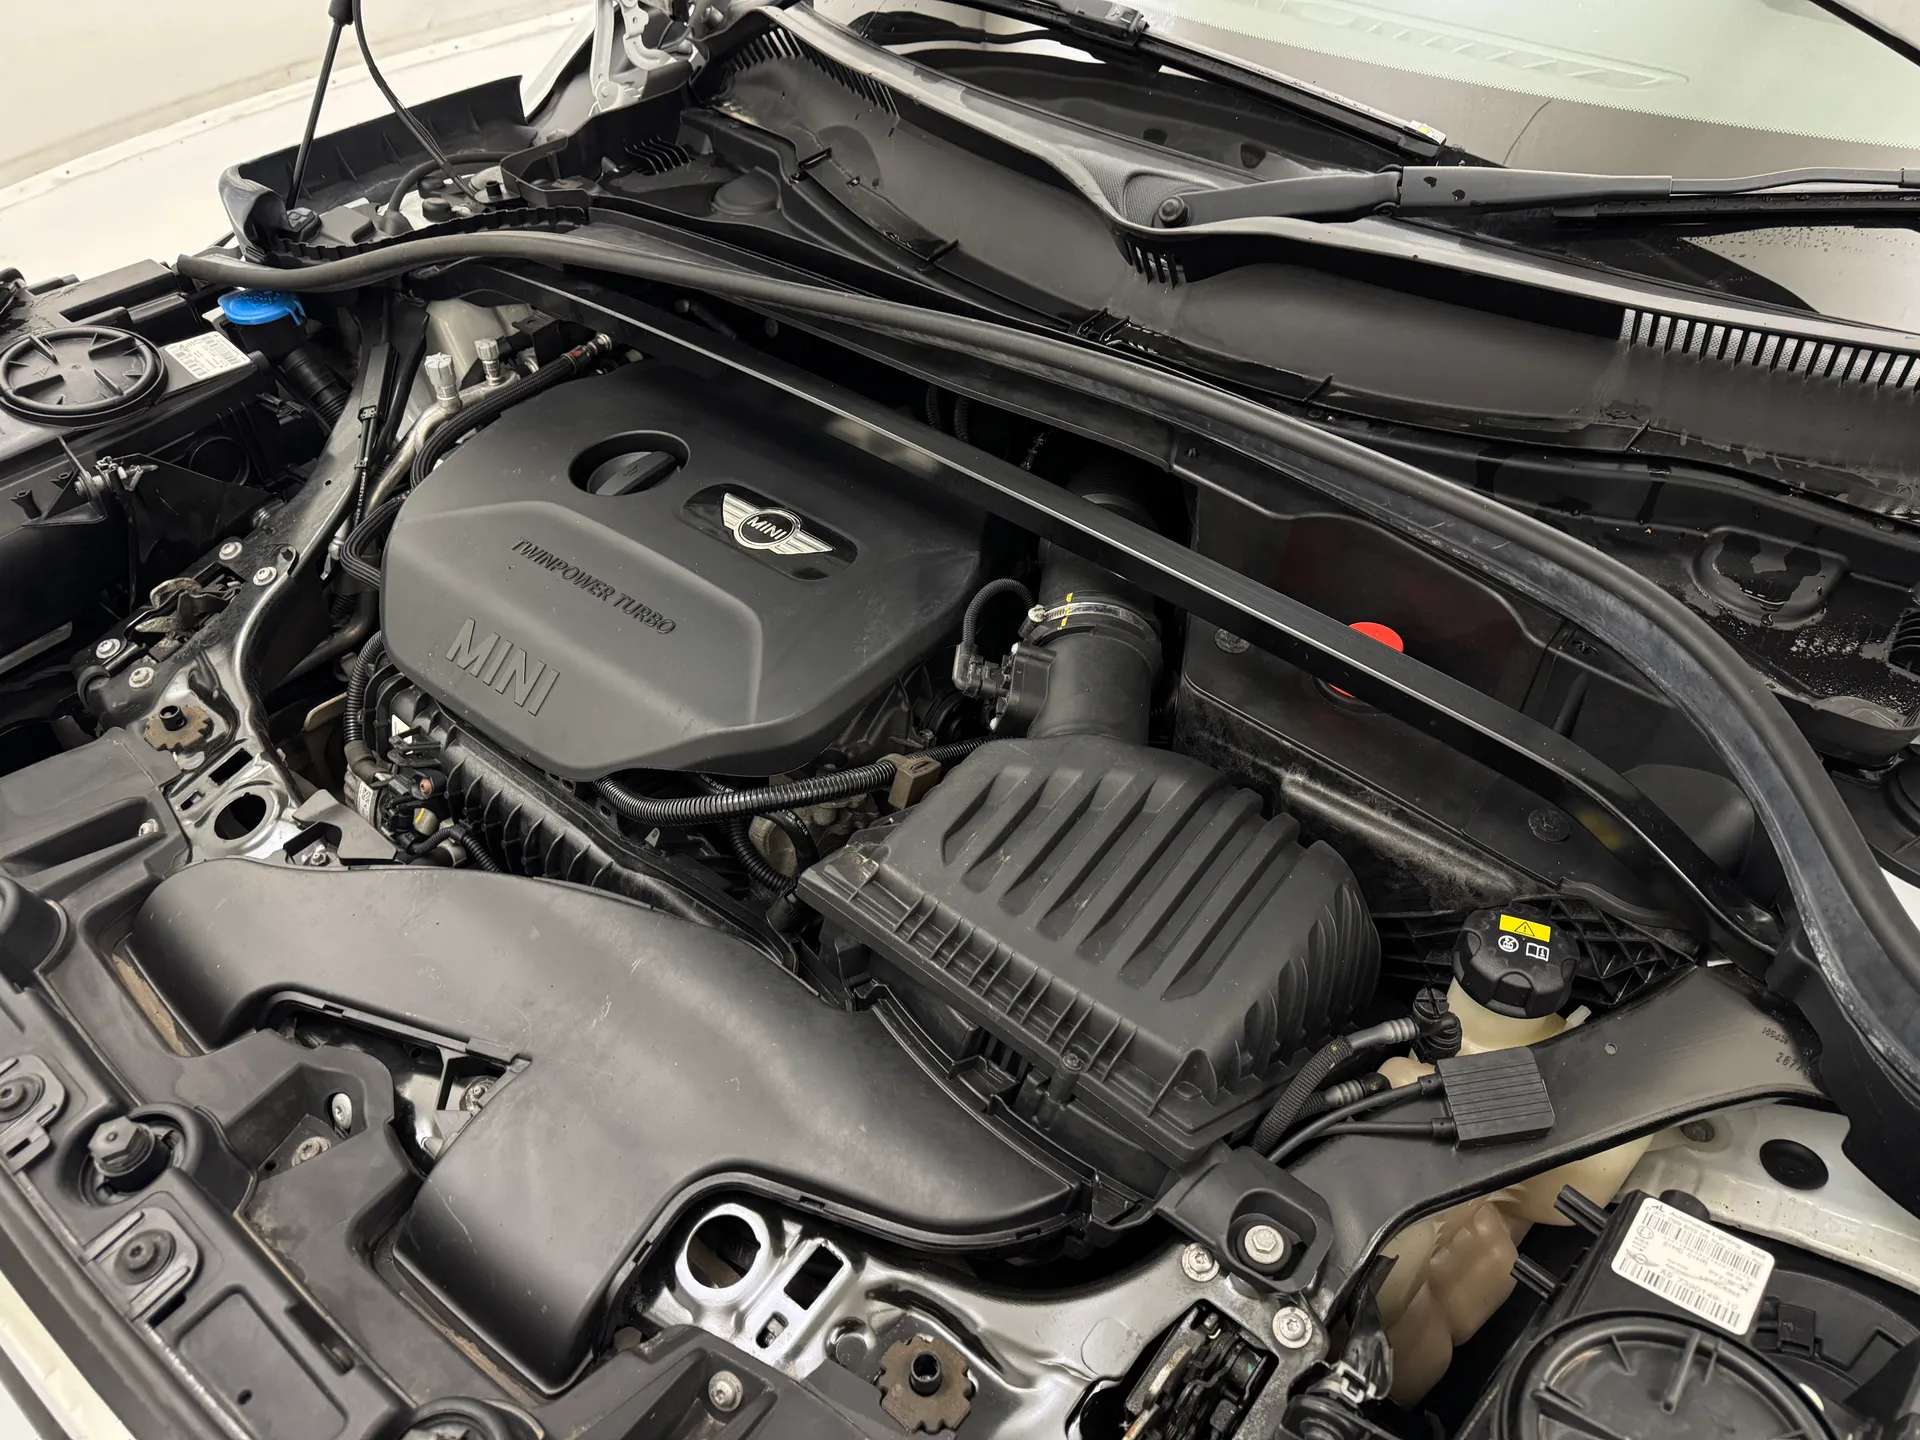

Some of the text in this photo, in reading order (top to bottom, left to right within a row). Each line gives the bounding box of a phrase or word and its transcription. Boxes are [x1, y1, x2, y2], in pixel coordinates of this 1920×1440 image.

[746, 516, 788, 540] MINI
[511, 537, 677, 634] TWINPOWER TURBO
[446, 616, 561, 717] MINI
